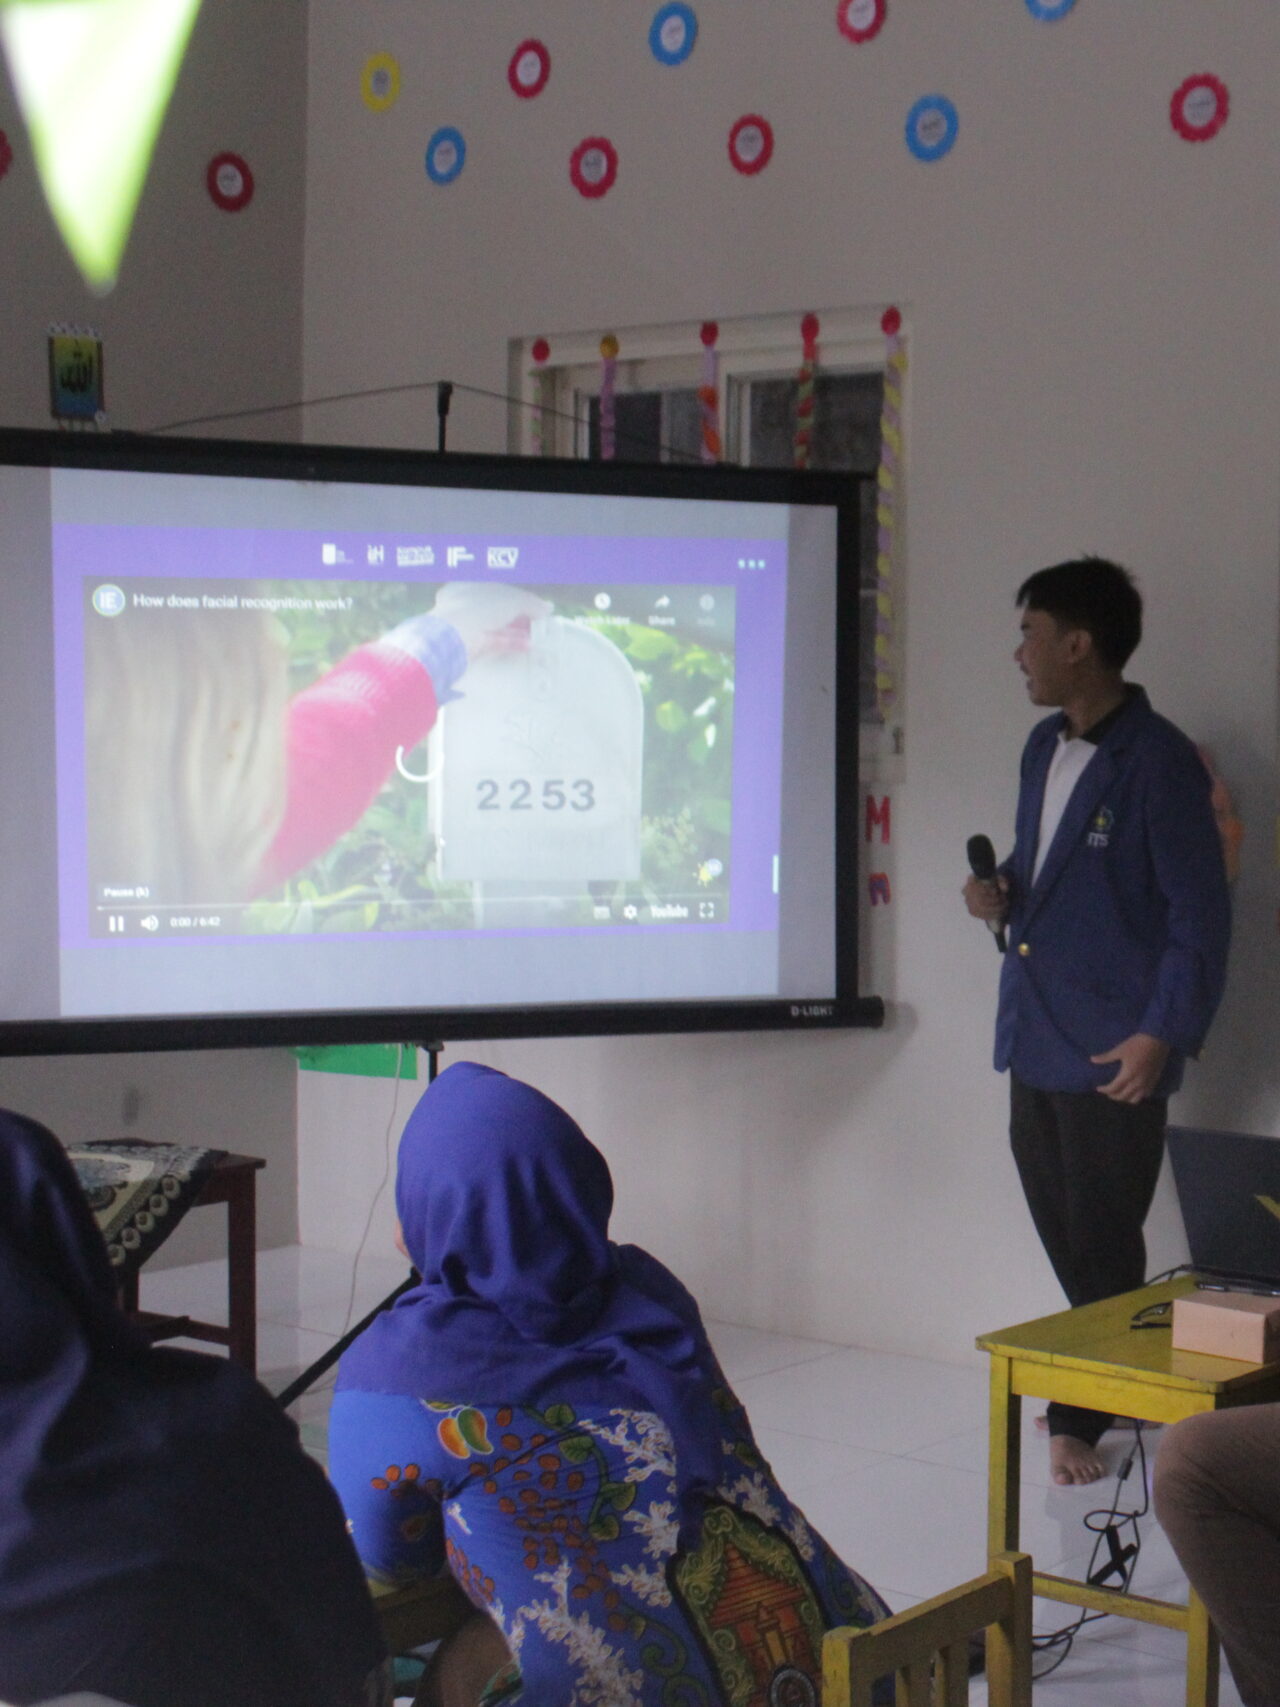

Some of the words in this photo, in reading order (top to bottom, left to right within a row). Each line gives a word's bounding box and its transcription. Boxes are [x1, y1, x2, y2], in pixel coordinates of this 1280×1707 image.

[132, 593, 164, 608] How
[167, 593, 200, 608] does
[202, 593, 238, 608] facial
[241, 594, 312, 611] recognition
[315, 596, 353, 610] work?
[476, 779, 596, 812] 2253
[865, 795, 890, 845] M
[104, 888, 134, 897] Pause
[170, 917, 191, 928] 0:00
[199, 917, 221, 927] 6:42
